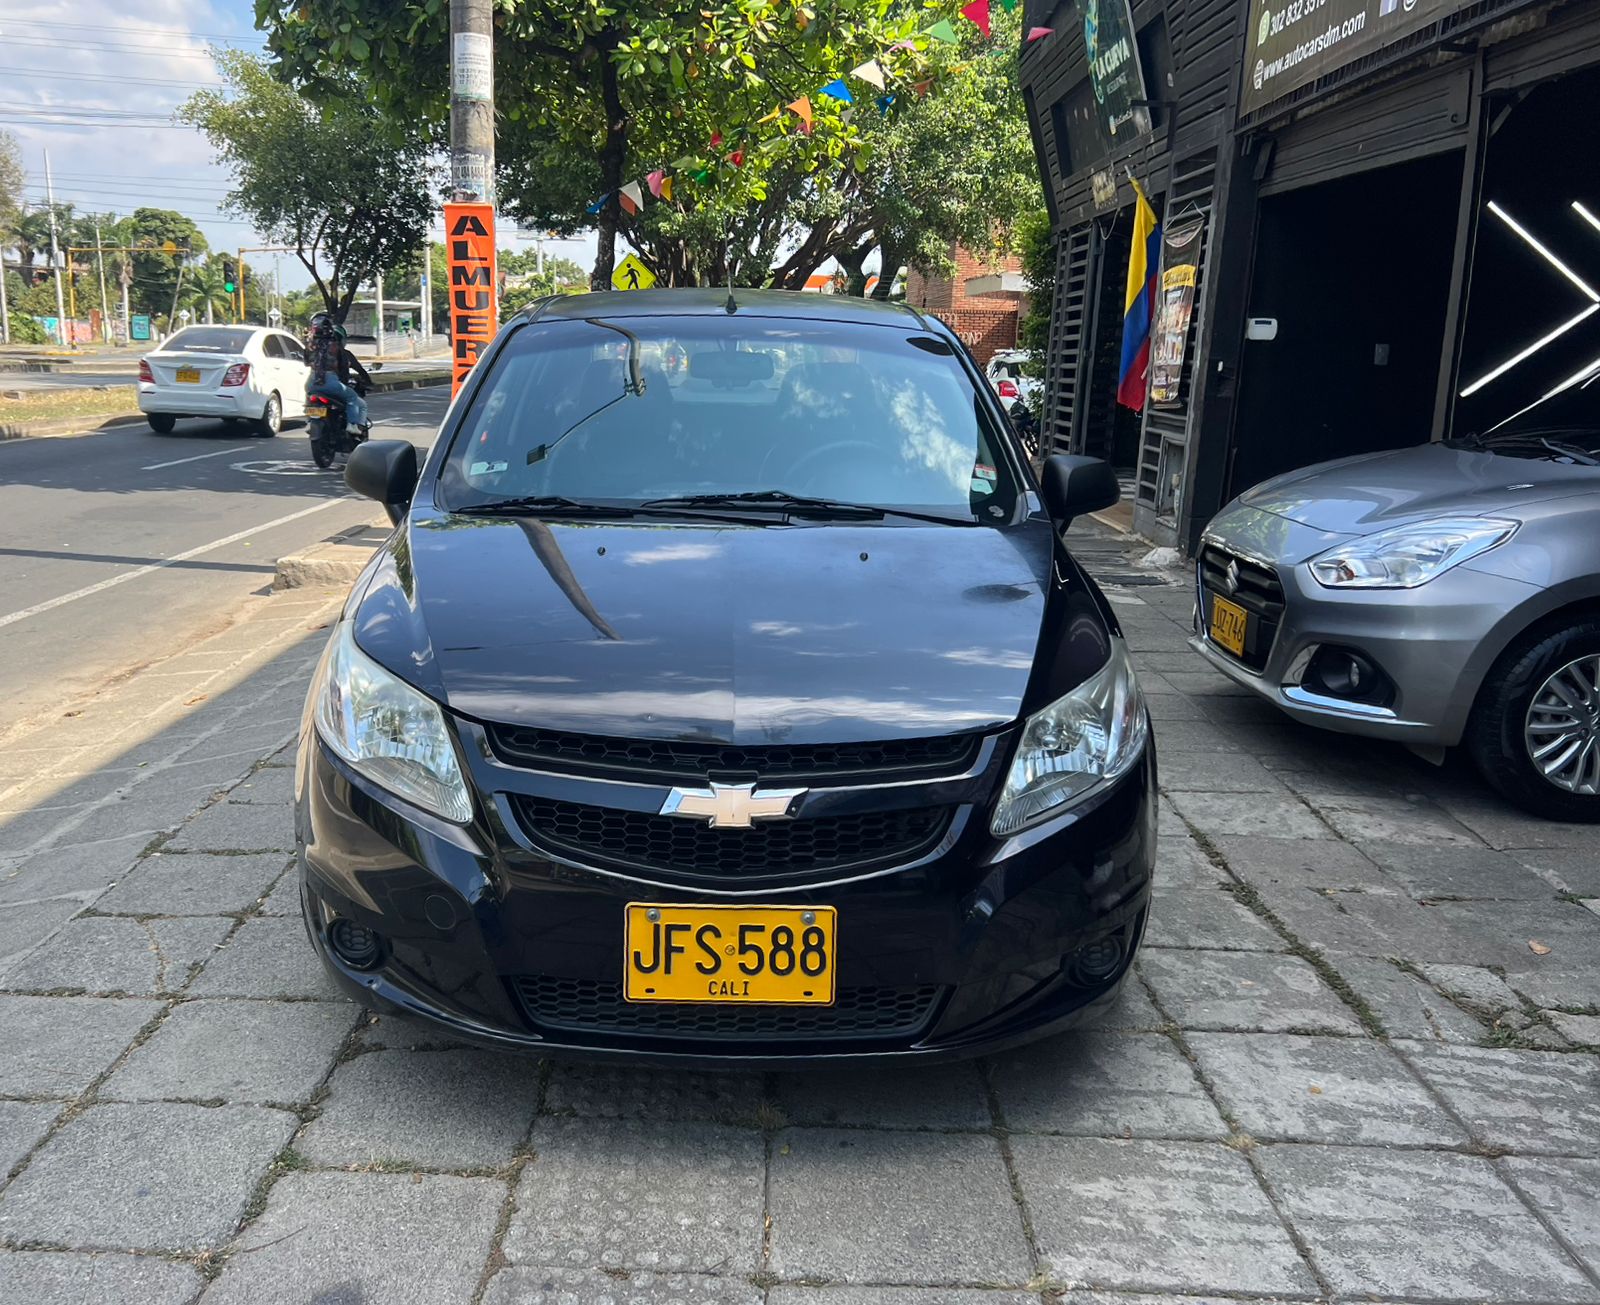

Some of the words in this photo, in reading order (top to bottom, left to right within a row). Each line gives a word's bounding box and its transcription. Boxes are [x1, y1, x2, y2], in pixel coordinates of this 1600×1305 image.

[1270, 9, 1285, 36] 302
[1285, 0, 1302, 26] 832
[1095, 56, 1107, 81] LA
[1104, 37, 1130, 73] CUEVA
[1263, 11, 1366, 81] www.autocarsdm.com
[451, 215, 491, 393] ALMUER
[633, 923, 722, 975] JFS
[738, 925, 827, 977] 588
[708, 980, 751, 996] CALI
